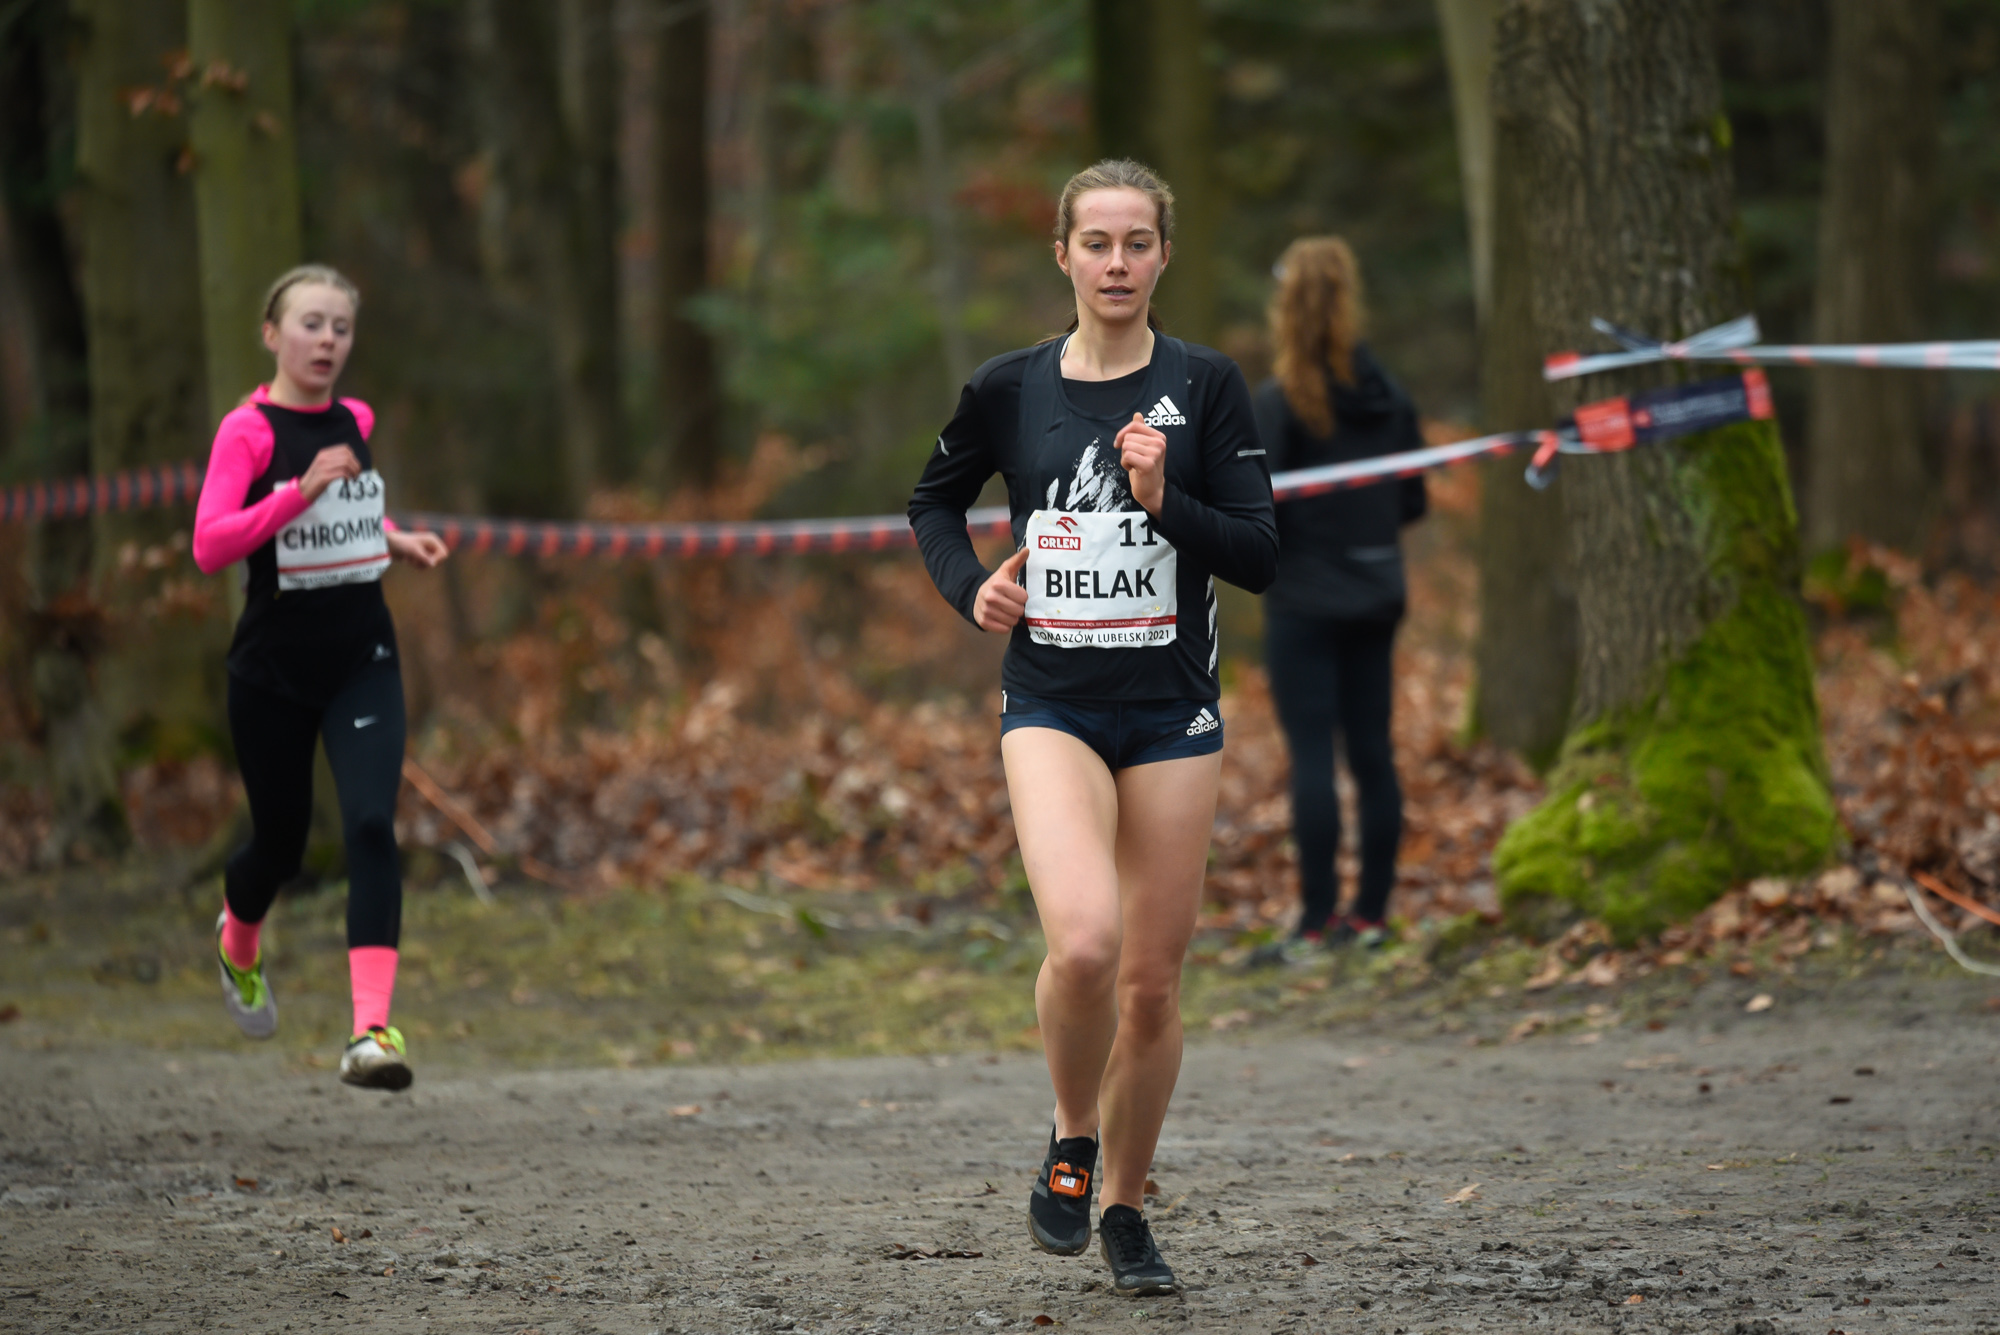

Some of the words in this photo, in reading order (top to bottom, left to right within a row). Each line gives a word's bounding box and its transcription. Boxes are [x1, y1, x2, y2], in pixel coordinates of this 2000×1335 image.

[1144, 414, 1186, 427] adidas
[283, 516, 382, 551] CHROMIK
[1118, 518, 1158, 547] 11
[1040, 537, 1079, 549] ORLEN
[1045, 568, 1157, 599] BIELAK
[1097, 632, 1146, 643] LUBELSKI
[1148, 629, 1169, 641] 2021
[1186, 719, 1219, 736] adidas
